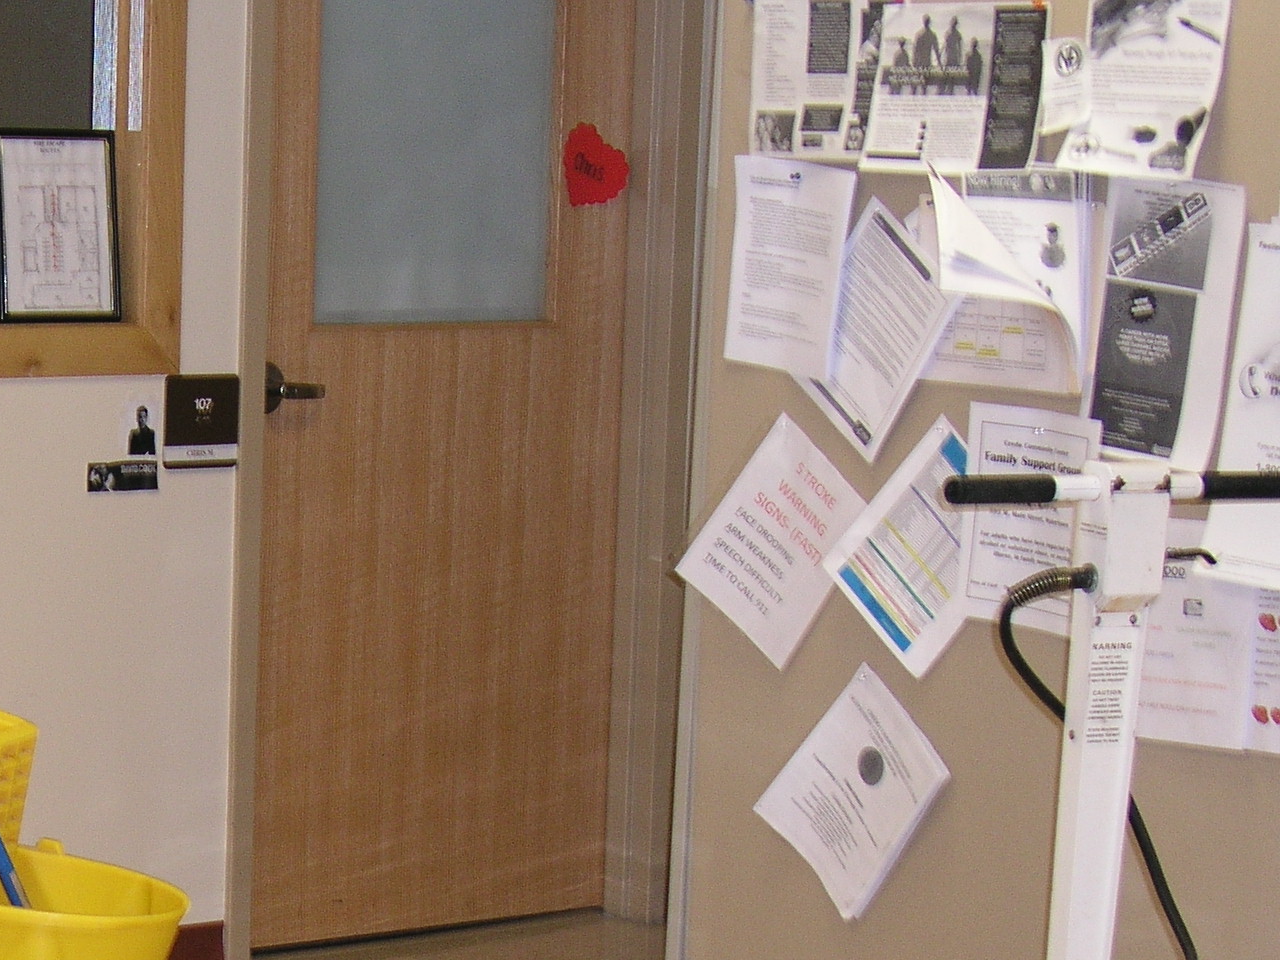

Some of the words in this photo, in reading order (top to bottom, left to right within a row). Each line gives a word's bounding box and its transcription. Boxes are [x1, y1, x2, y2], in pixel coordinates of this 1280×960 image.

[194, 398, 213, 410] 107
[984, 450, 1017, 467] Family
[1020, 455, 1056, 473] Support
[778, 479, 828, 538] WARNING
[724, 522, 745, 542] ARM
[745, 535, 784, 580] WEAKNESS
[734, 506, 757, 528] FACE
[756, 523, 795, 567] DROOPING
[789, 526, 821, 567] (FAST)
[703, 552, 726, 574] TIME
[726, 569, 737, 585] TO
[736, 579, 754, 601] CALL
[714, 536, 745, 568] SPEECH
[744, 562, 784, 605] DIFFICULTY
